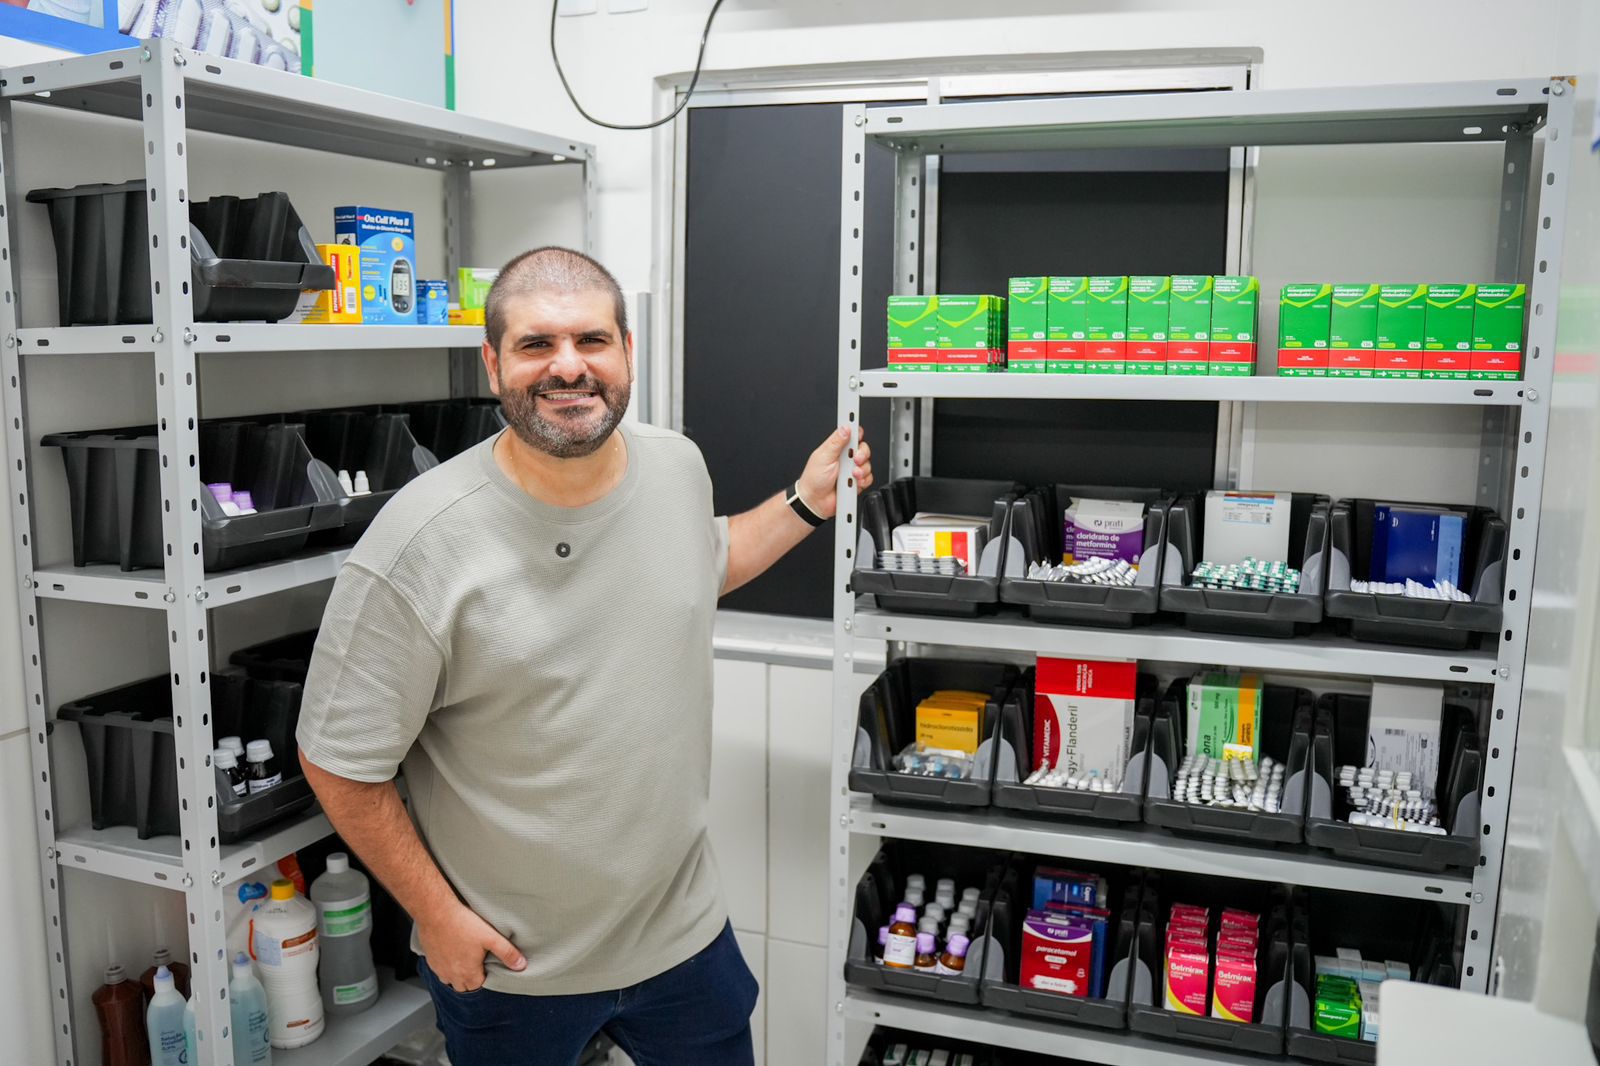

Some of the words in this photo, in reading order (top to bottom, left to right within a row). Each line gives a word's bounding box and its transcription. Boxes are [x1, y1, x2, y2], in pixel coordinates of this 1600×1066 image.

[1104, 520, 1123, 529] prati
[1076, 532, 1109, 541] cloridrato
[1076, 540, 1117, 549] metformina
[1204, 735, 1212, 757] ona
[1036, 946, 1077, 956] paracetamol
